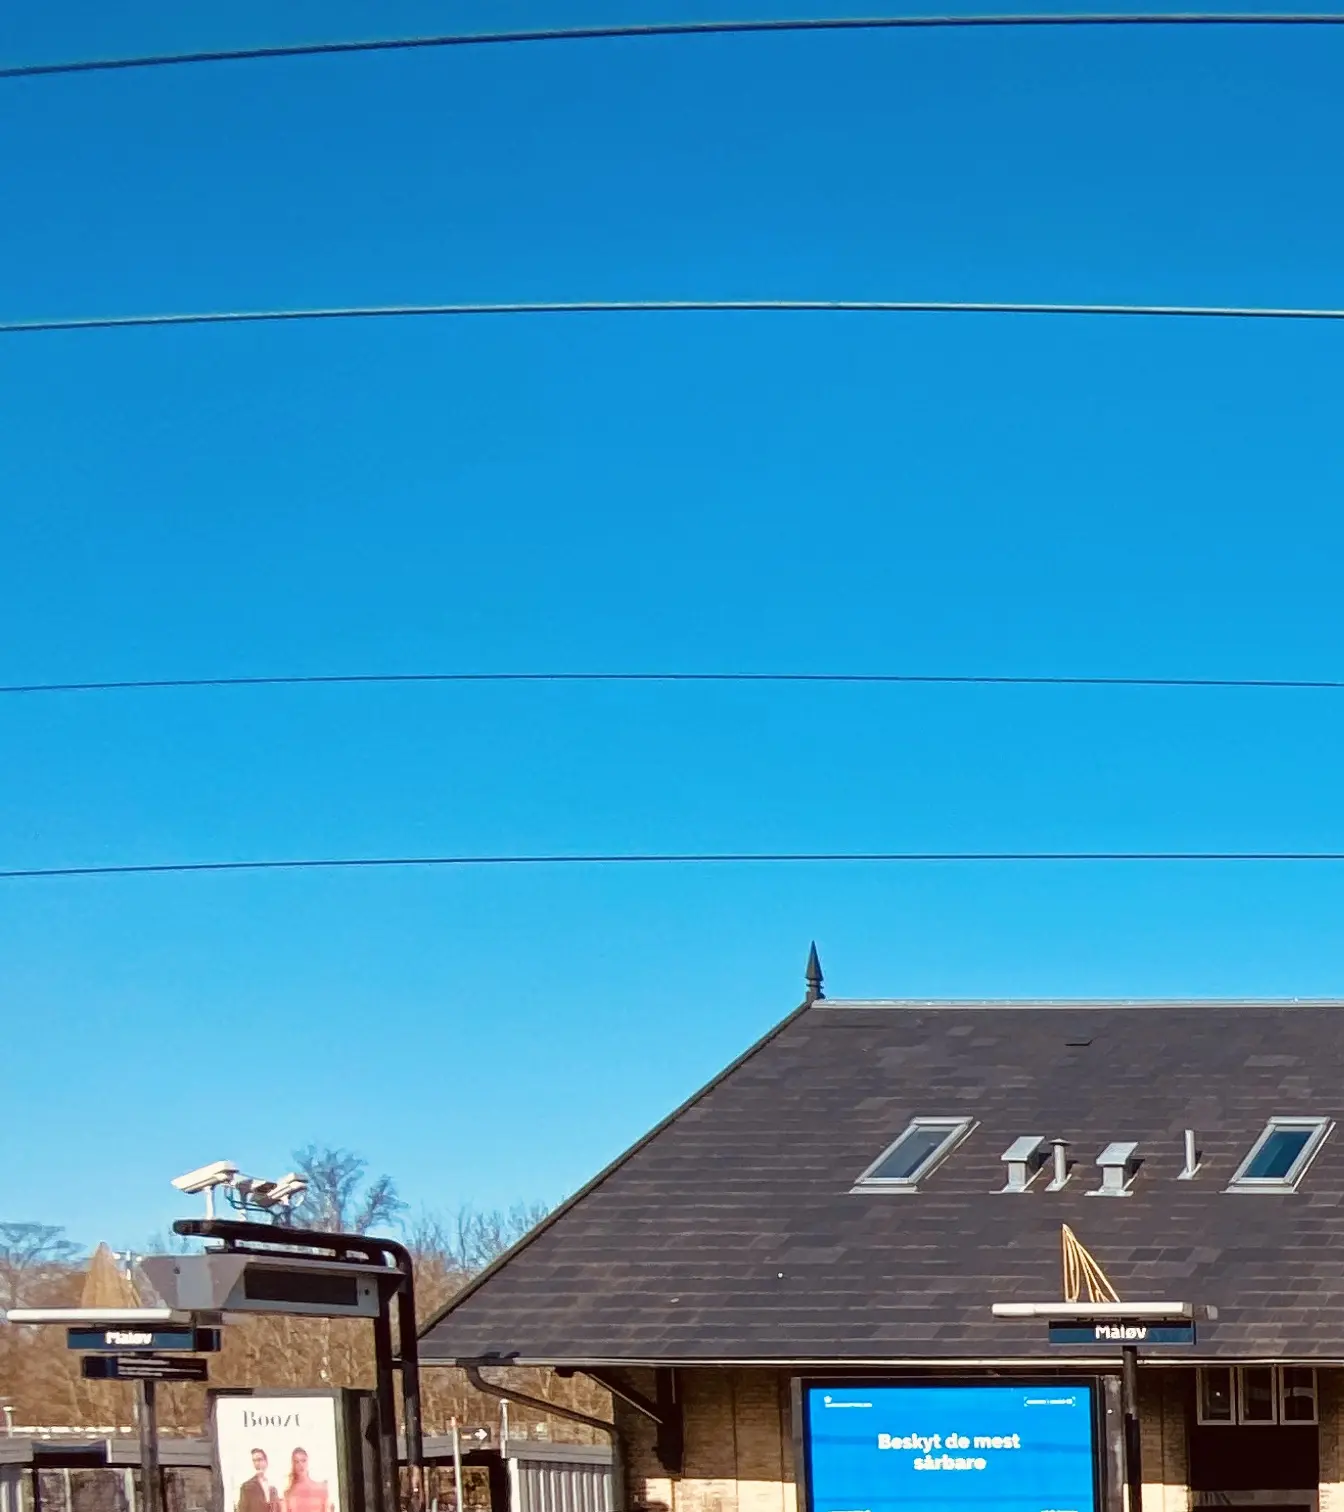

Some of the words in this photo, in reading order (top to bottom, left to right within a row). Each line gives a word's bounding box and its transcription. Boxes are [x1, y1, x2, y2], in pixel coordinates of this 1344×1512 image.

[878, 1433, 942, 1454] Beskyt
[945, 1433, 970, 1449] de
[974, 1433, 1021, 1449] mest
[914, 1454, 987, 1471] sårbare
